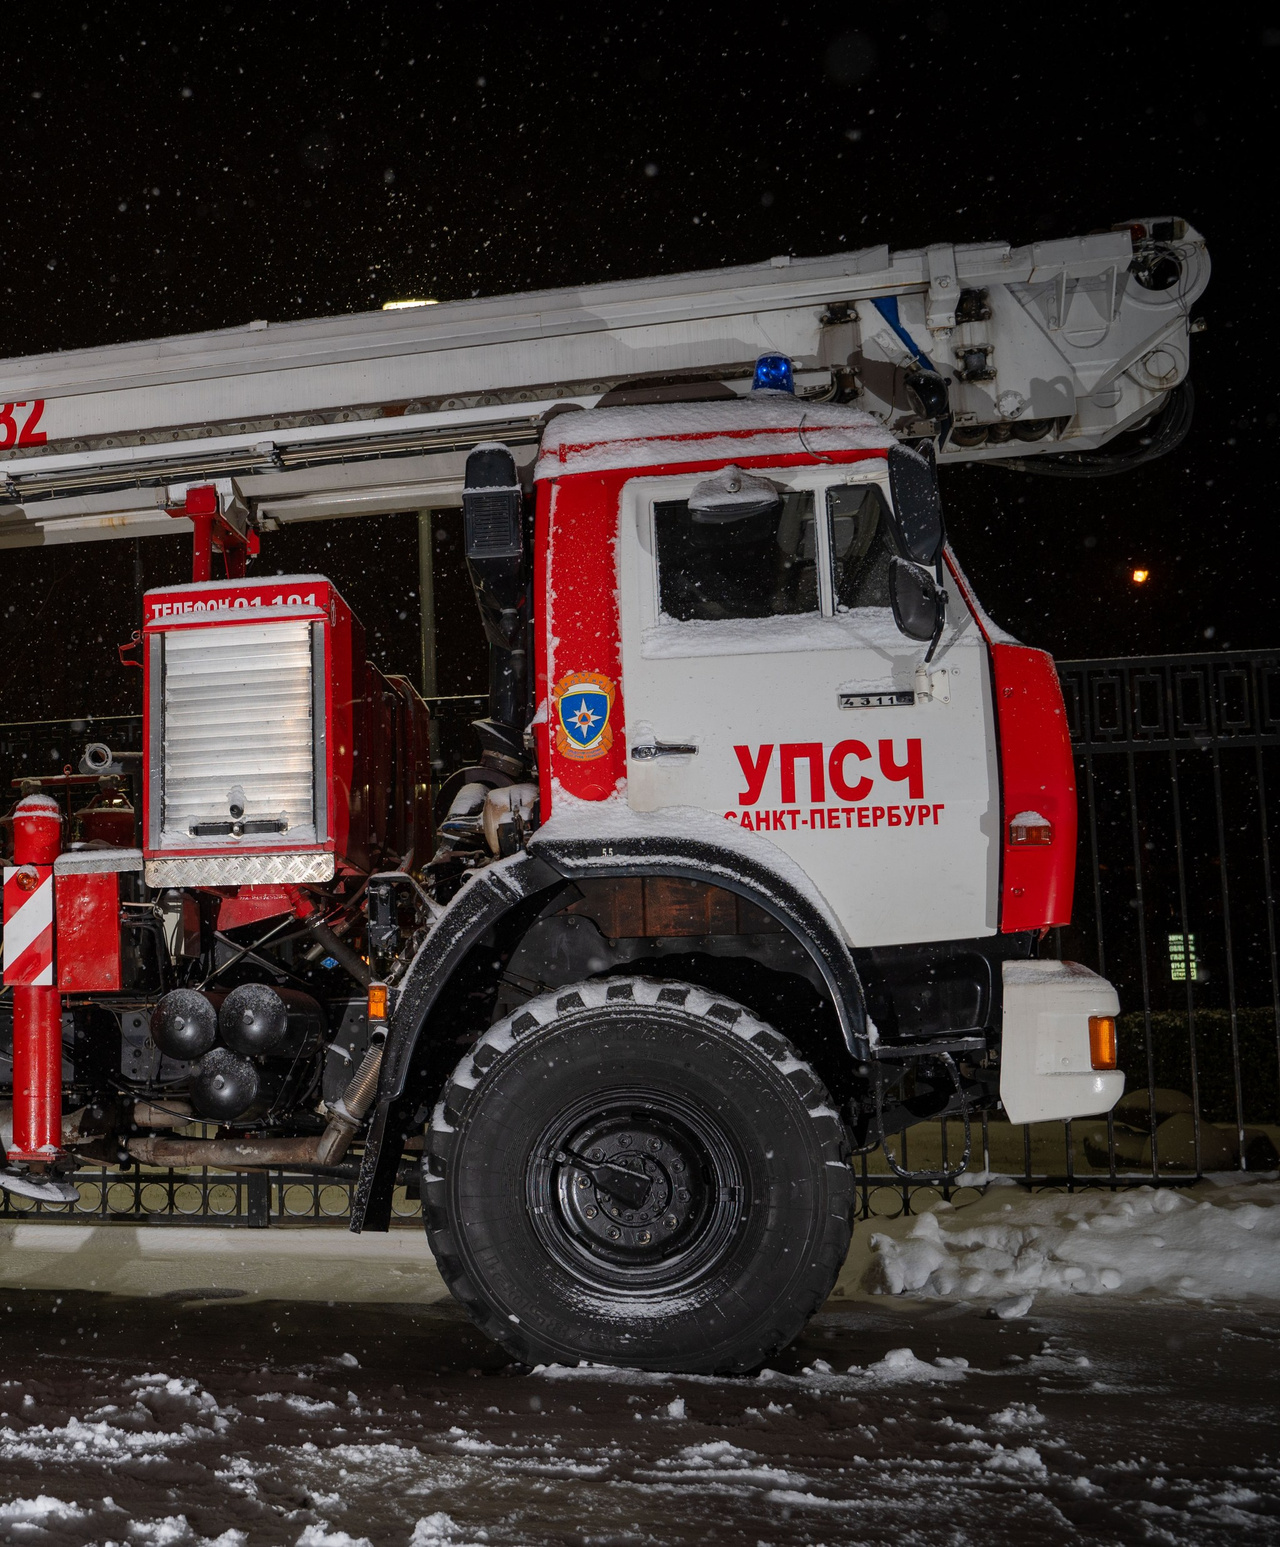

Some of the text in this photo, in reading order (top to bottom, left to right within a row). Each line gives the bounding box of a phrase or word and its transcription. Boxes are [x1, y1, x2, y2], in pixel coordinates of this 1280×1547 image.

[152, 599, 229, 618] ТЕЛЕФОН
[844, 696, 912, 706] 4311
[733, 738, 924, 806] УПСЧ
